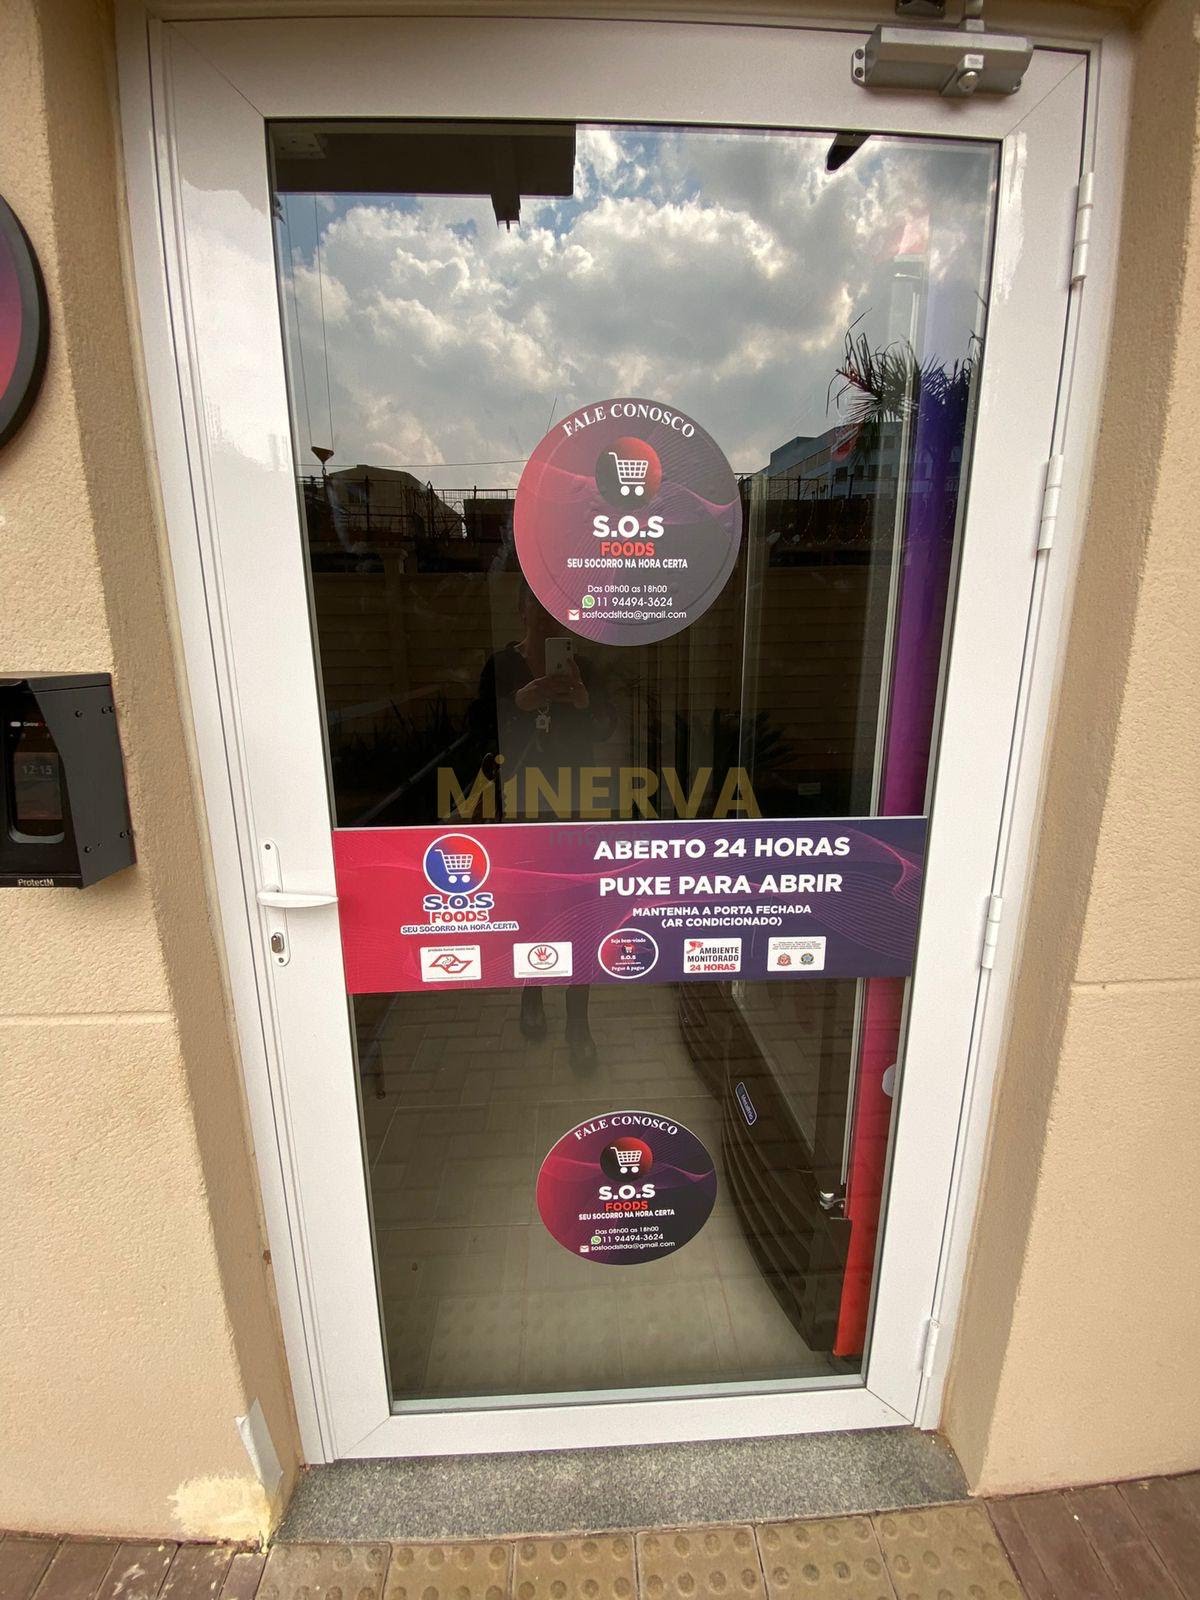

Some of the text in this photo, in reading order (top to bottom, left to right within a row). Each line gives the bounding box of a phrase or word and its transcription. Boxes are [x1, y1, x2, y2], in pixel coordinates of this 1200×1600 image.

[562, 403, 695, 438] FALE CONOSCO
[593, 515, 664, 538] S.O.S
[600, 541, 655, 557] FOODS
[567, 558, 688, 569] SEU SOCORRO NA HORA CERTA
[587, 585, 603, 593] Das
[604, 585, 629, 593] 08h00
[643, 585, 668, 593] 18h00
[597, 597, 673, 607] 11 94494-3624
[582, 610, 687, 620] sosfoodsltda@gmail.com
[594, 837, 850, 860] ABERTO 24 HORAS
[600, 874, 843, 896] PUXE PARA ABRIR
[425, 894, 493, 910] S.O.S
[431, 910, 488, 923] FOODS
[632, 904, 811, 917] MANTENHA A PORTA FECHADA
[661, 916, 783, 928] (AR CONDICIONADO)
[704, 963, 736, 971] HORAS
[574, 1115, 678, 1140] FALE CONOSCO
[598, 1184, 655, 1200] S.O.S
[605, 1201, 648, 1212] FOODS
[593, 1212, 623, 1220] SOCORRO
[614, 1233, 664, 1242] 94494-3624
